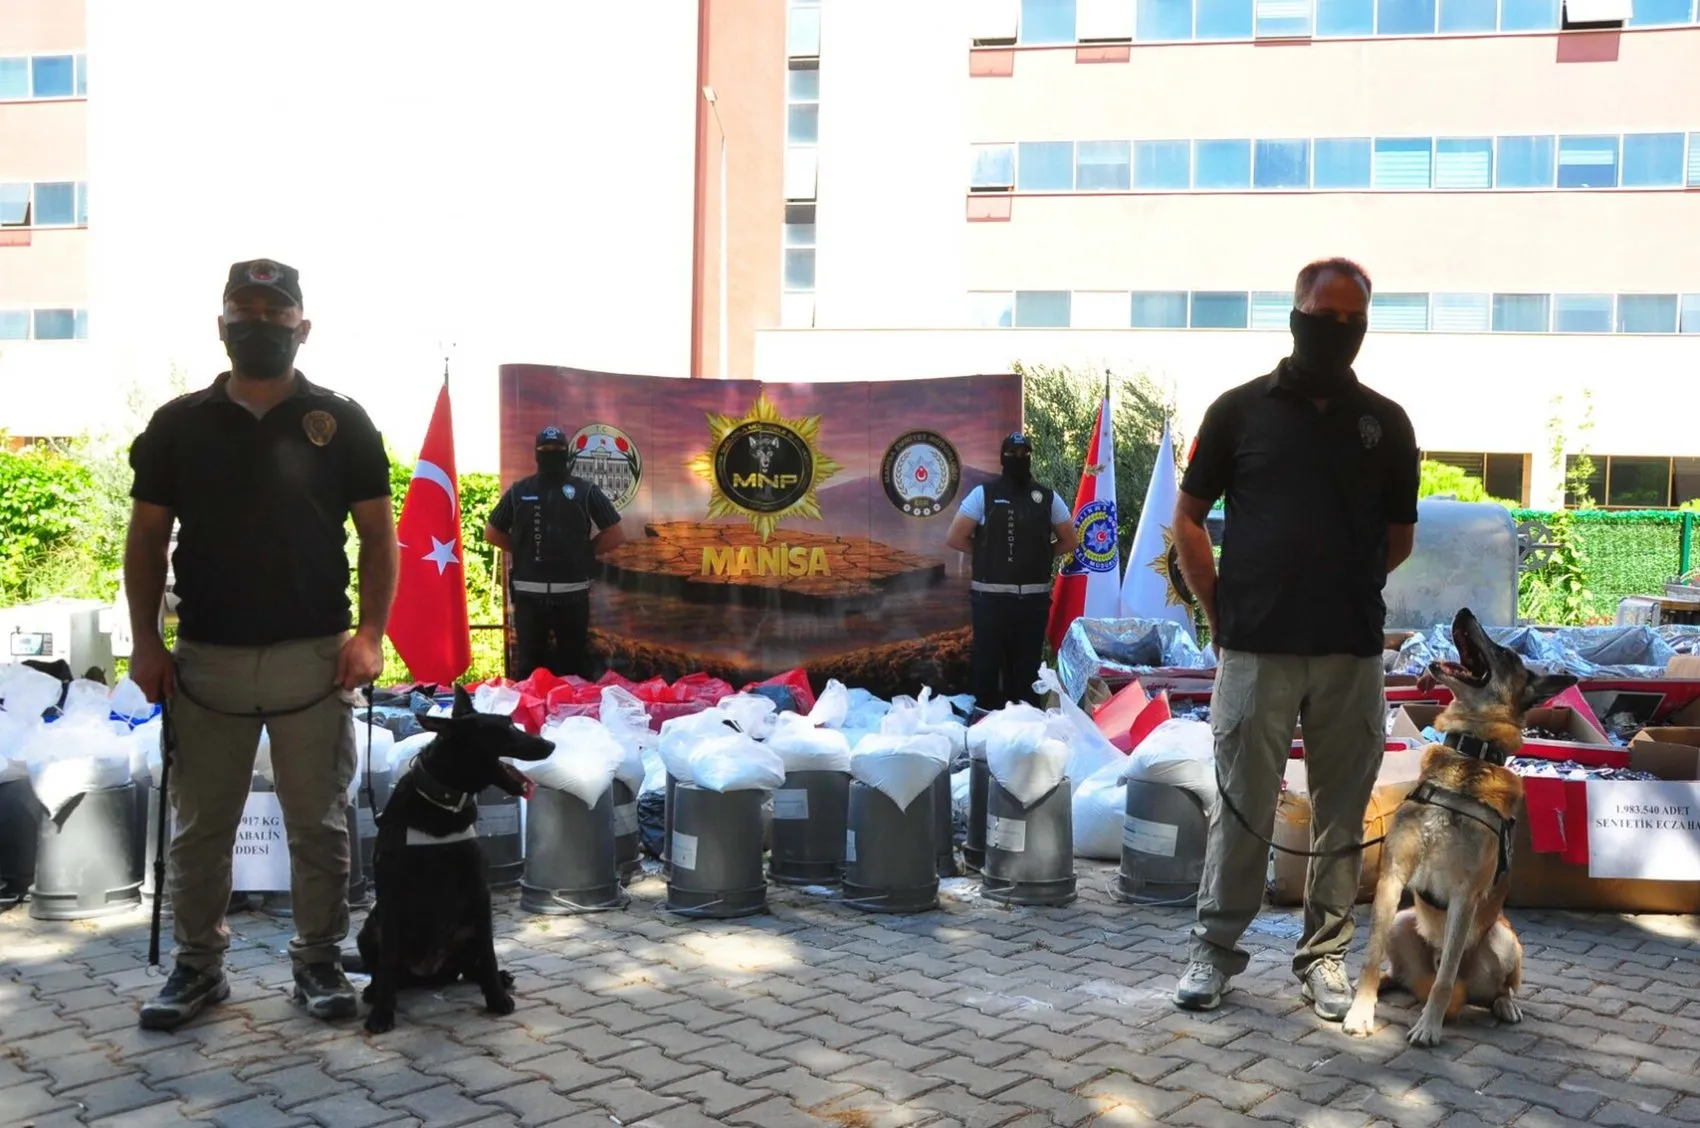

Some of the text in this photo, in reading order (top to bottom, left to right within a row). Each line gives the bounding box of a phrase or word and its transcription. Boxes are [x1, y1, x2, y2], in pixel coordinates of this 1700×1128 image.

[732, 472, 798, 489] MNP
[701, 542, 832, 577] MANİSA
[1616, 805, 1690, 816] 1.983.540 ADET
[262, 816, 280, 826] KG
[1595, 818, 1653, 829] SENTETİK
[237, 829, 280, 840] ABALİN
[235, 843, 269, 855] DDESİ
